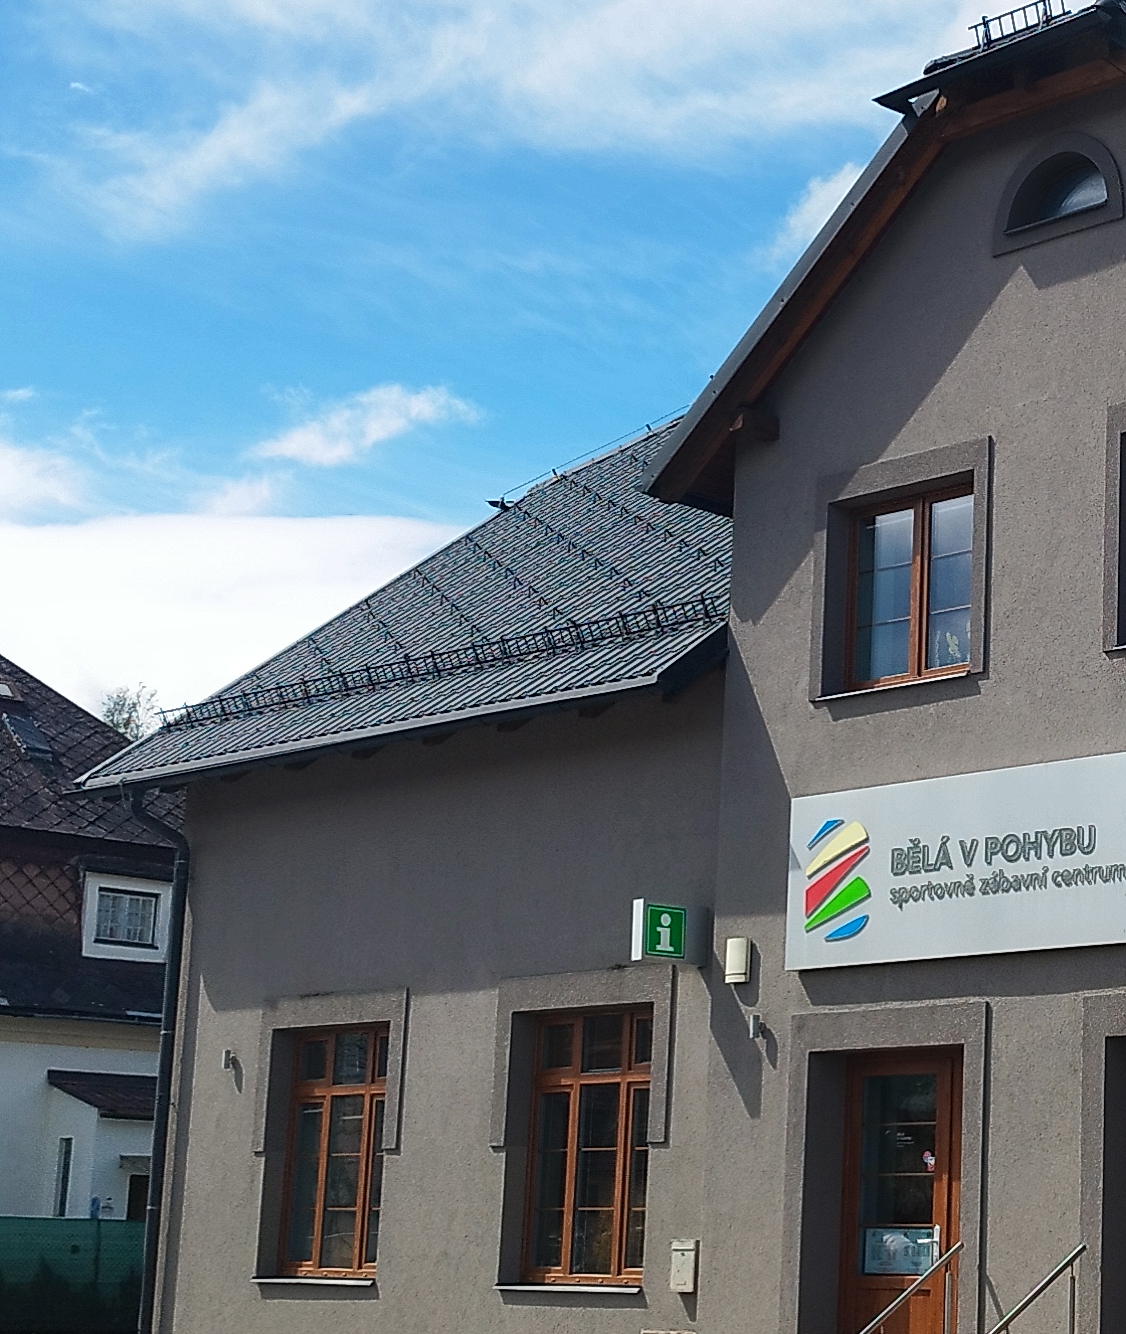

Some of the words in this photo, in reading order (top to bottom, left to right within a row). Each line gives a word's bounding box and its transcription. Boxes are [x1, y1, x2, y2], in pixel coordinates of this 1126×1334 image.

[890, 835, 954, 876] BĚLÁ
[958, 838, 979, 868] V
[984, 824, 1097, 866] POHYBU
[889, 873, 976, 911] sportovně
[979, 865, 1049, 896] zábavní
